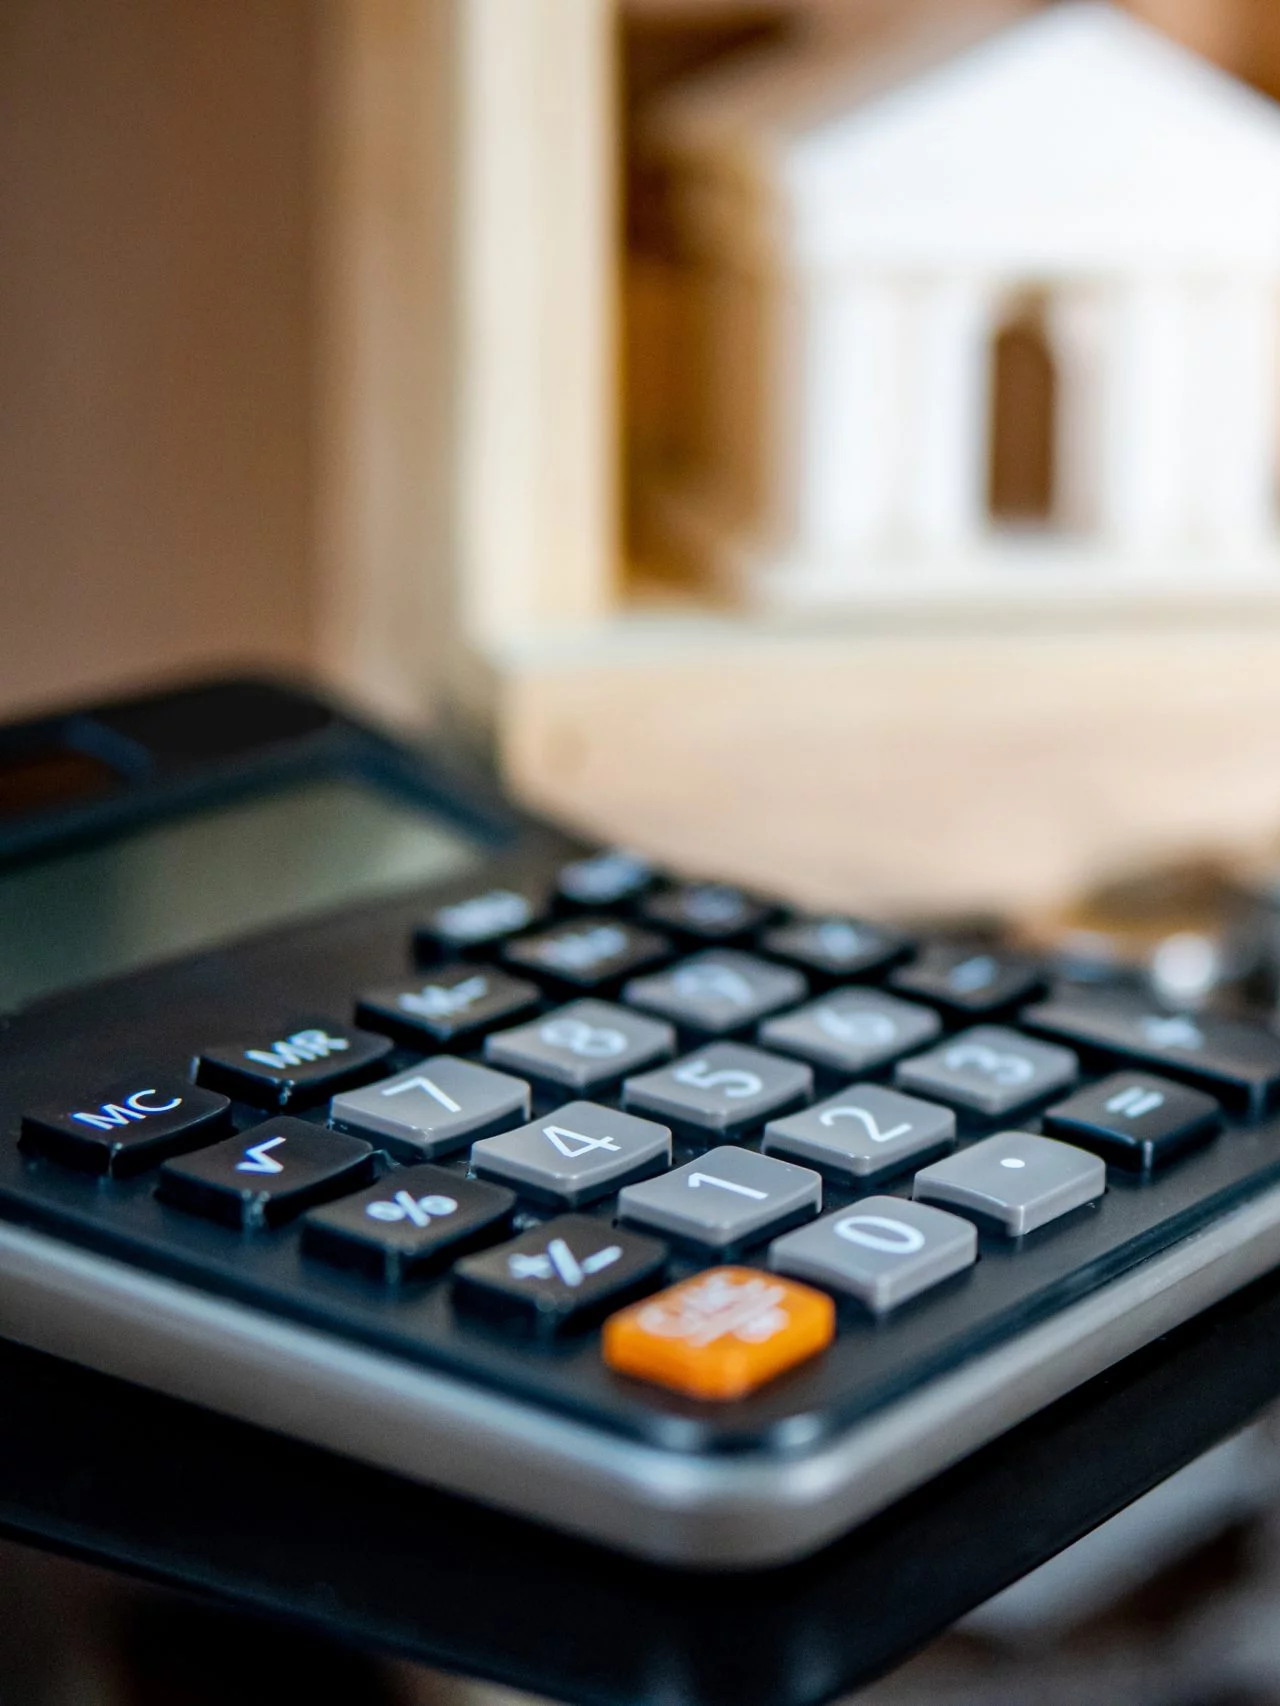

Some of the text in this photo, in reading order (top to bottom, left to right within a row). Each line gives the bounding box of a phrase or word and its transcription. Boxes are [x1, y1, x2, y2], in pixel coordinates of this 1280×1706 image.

[538, 1018, 629, 1058] 8
[814, 1006, 897, 1047] 6
[244, 1028, 350, 1070] MR
[943, 1043, 1035, 1086] 3
[381, 1075, 463, 1113] 7
[673, 1058, 763, 1098] 5
[70, 1088, 183, 1131] MC
[819, 1105, 914, 1143] 2
[541, 1124, 622, 1159] 4
[687, 1171, 769, 1201] 1
[365, 1189, 459, 1228] %
[832, 1214, 926, 1255] 0
